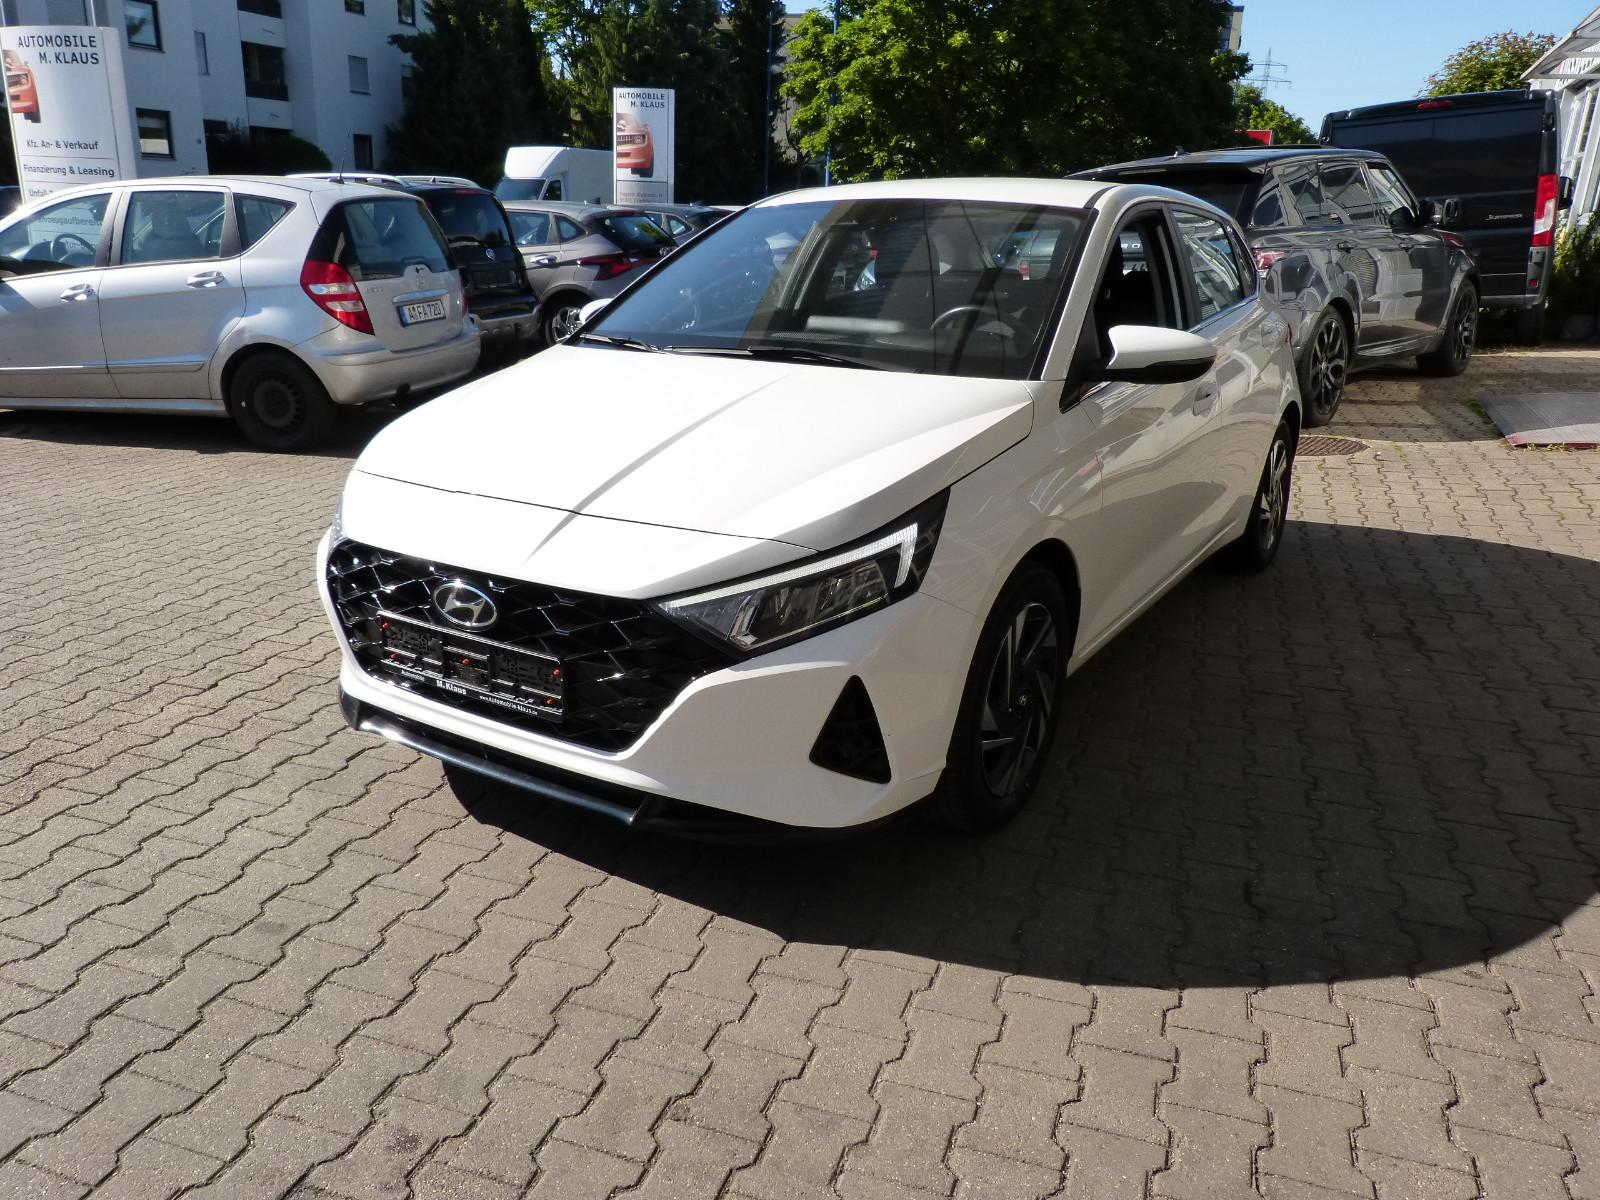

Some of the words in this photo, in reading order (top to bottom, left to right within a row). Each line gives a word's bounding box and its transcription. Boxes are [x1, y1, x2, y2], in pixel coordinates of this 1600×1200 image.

[18, 35, 97, 48] AUTOMOBILE
[39, 52, 51, 64] M.
[55, 52, 100, 65] KLAUS
[618, 92, 665, 100] AUTOMOBILE
[640, 101, 665, 109] KLAUS
[55, 140, 61, 149] &
[63, 140, 99, 150] Verkauf
[23, 164, 67, 176] Finanzierung
[69, 166, 75, 175] &
[78, 166, 115, 178] Leasing
